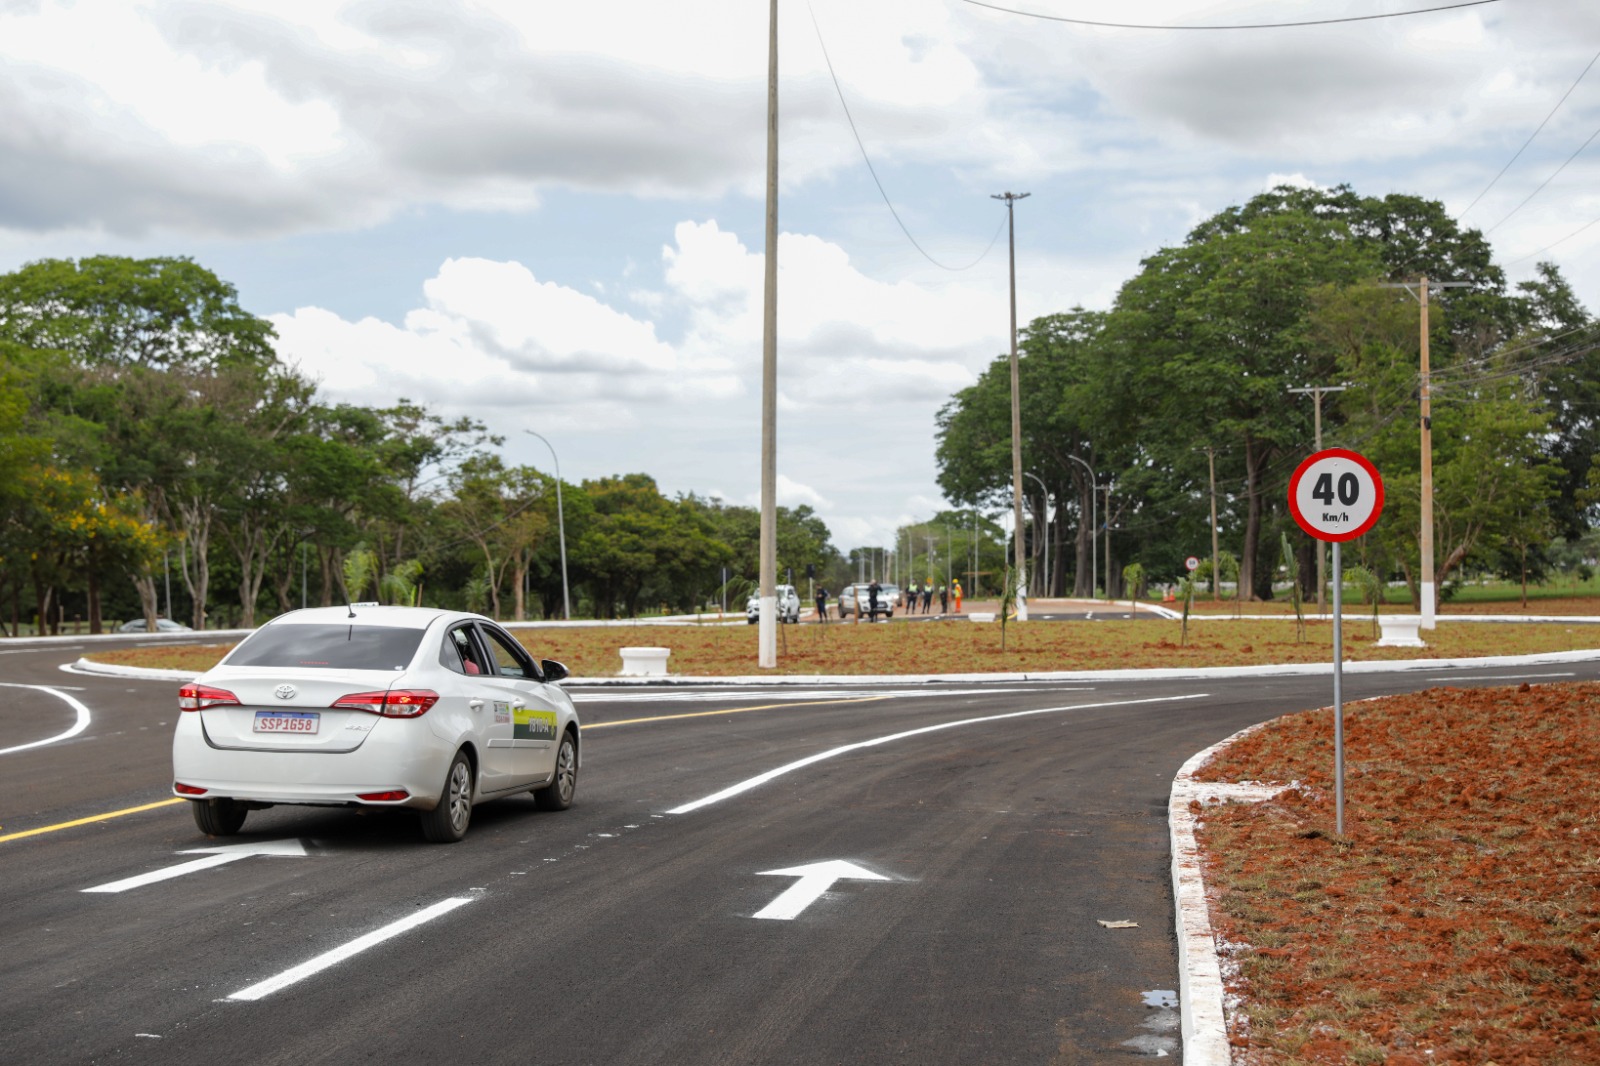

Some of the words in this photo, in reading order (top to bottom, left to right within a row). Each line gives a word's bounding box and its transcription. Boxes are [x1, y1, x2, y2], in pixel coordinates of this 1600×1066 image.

[1312, 472, 1360, 506] 40
[1322, 512, 1349, 522] Km/h
[260, 718, 312, 731] SSP1G58
